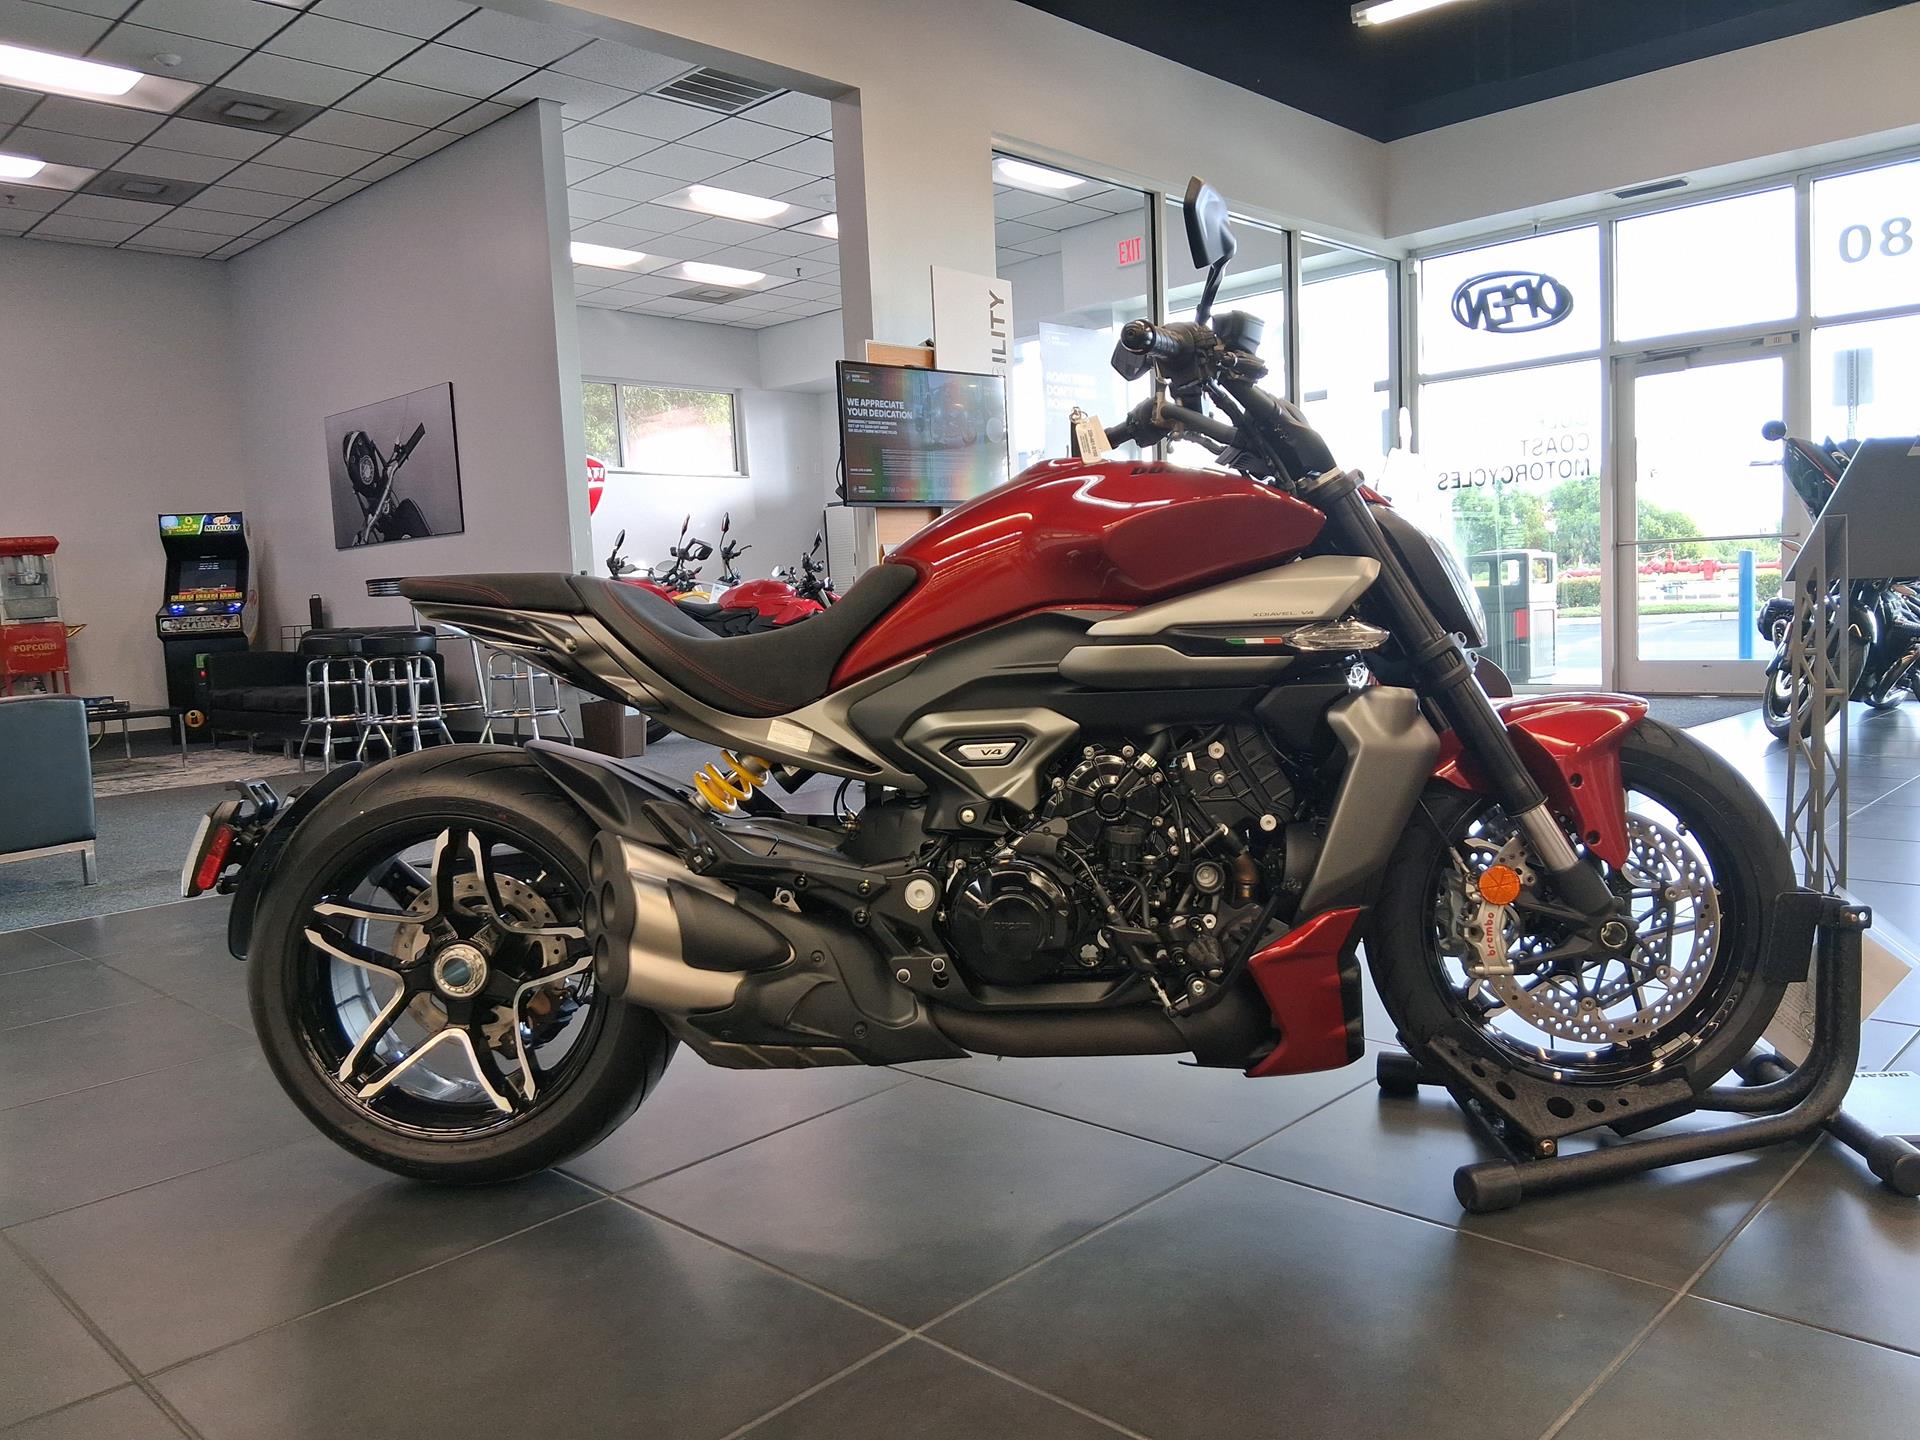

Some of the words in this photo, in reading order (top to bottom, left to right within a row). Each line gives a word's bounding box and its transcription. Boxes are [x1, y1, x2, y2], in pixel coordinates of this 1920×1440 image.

[1118, 236, 1141, 265] EXIT
[846, 397, 860, 407] WE
[860, 399, 905, 410] APPRECIATE
[847, 407, 868, 417] YOUR
[868, 409, 913, 420] DEDICATION
[204, 523, 241, 532] MIDWAY
[13, 643, 57, 653] POPCORN
[980, 748, 1003, 756] V4
[1484, 912, 1496, 957] brembo
